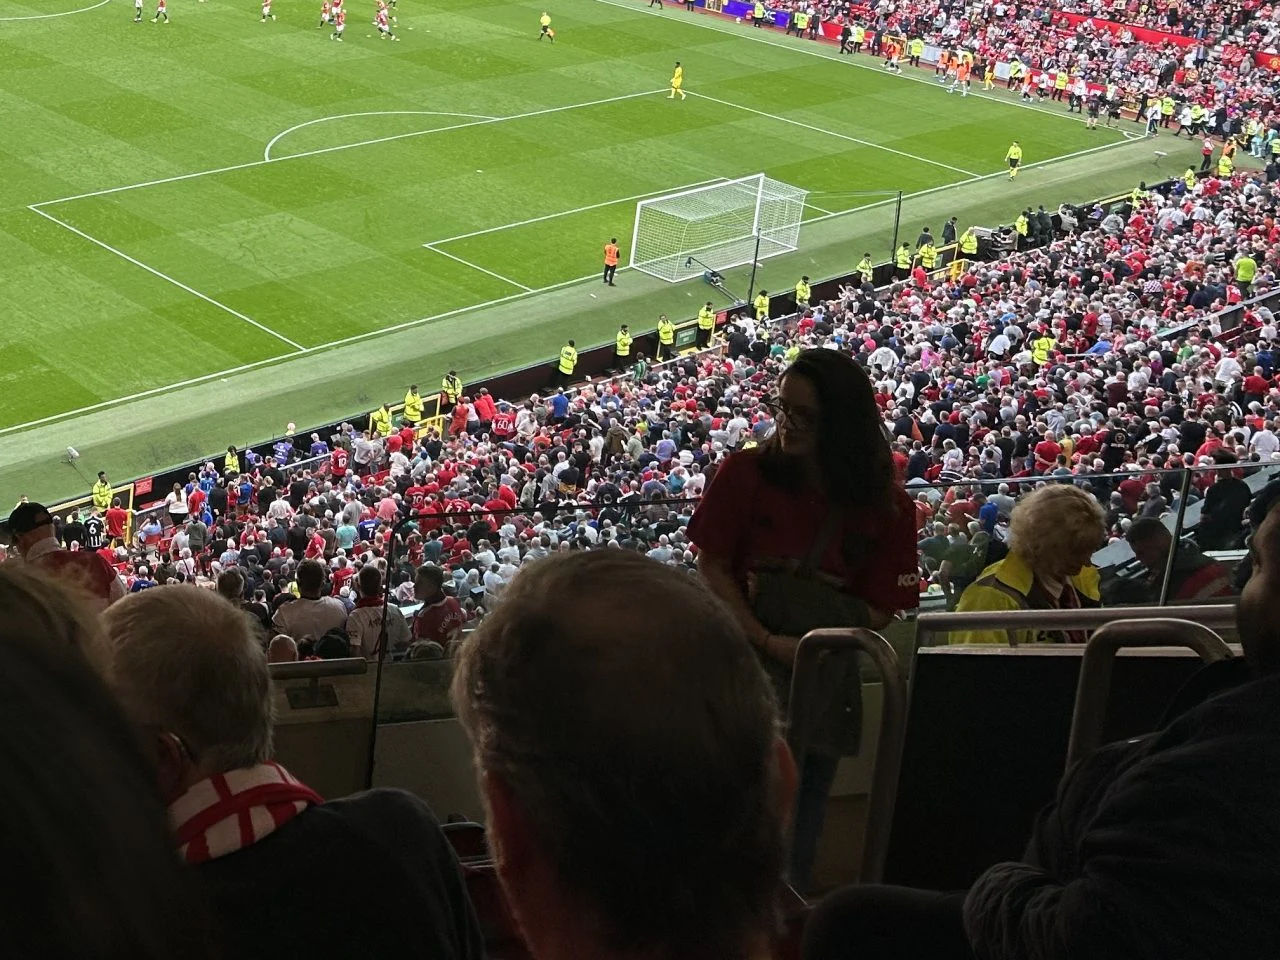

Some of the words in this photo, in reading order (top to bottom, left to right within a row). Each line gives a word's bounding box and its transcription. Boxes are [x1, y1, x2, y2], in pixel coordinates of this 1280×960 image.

[412, 495, 424, 505] 10
[89, 523, 97, 535] 6
[367, 528, 374, 539] 7
